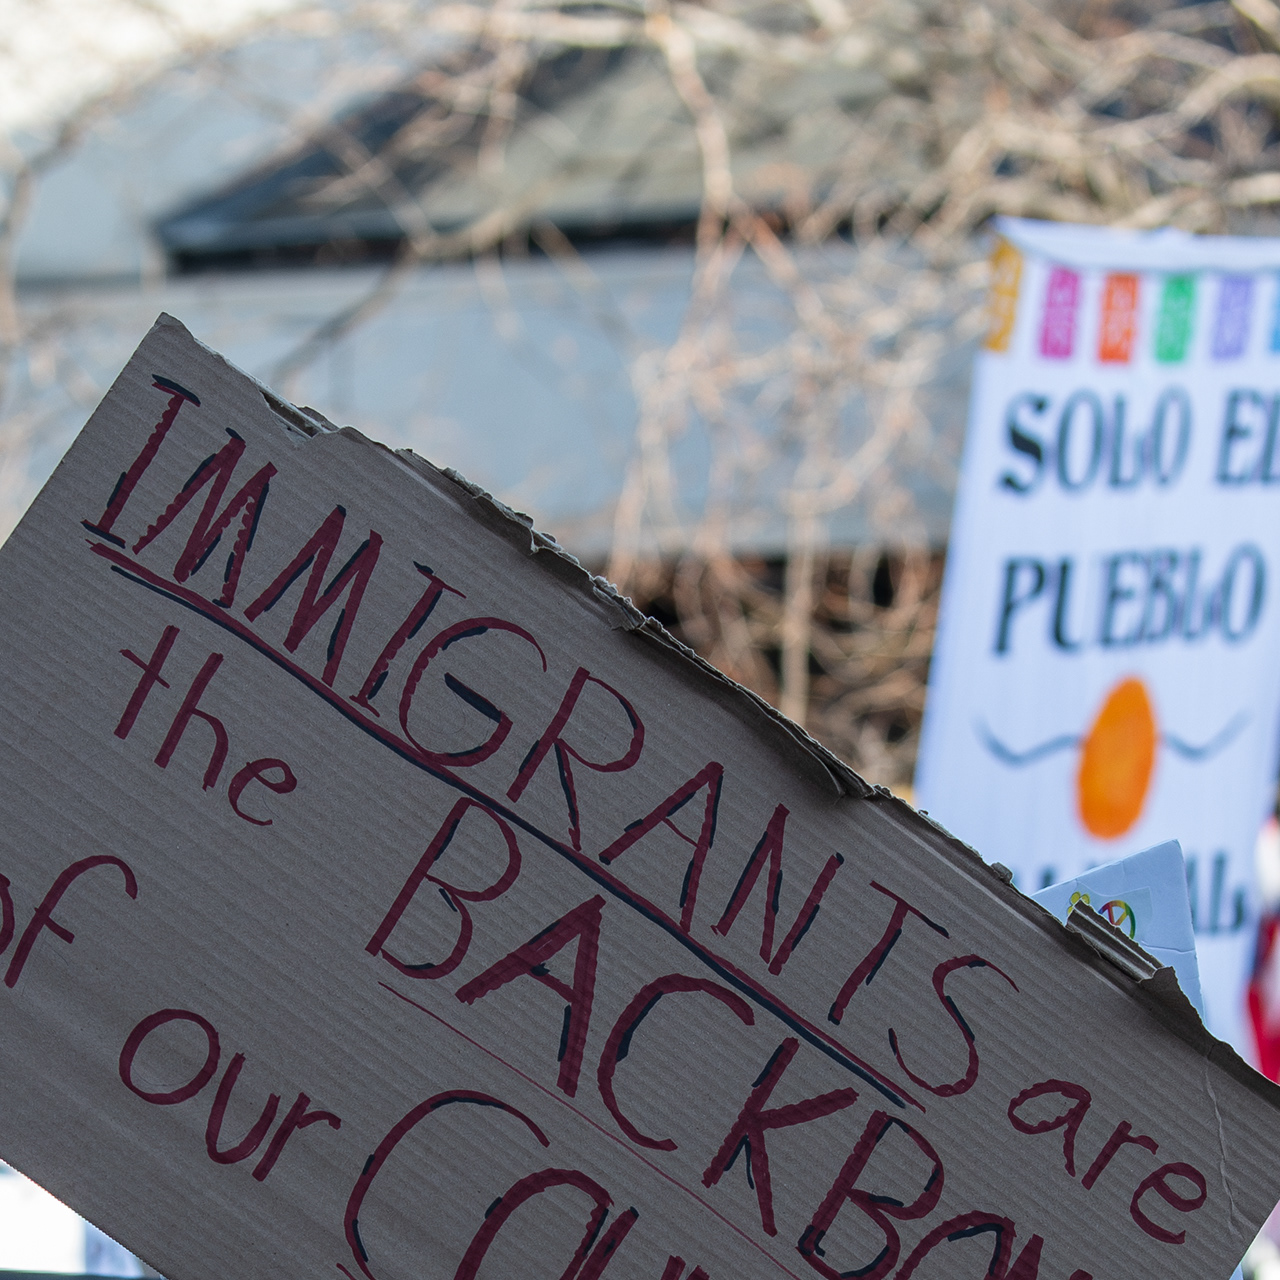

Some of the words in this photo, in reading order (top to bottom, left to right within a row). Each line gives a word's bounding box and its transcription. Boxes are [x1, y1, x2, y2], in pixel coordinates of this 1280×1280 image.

[996, 386, 1192, 495] SOLO
[992, 542, 1268, 657] PUEBLO
[81, 375, 1019, 1097] IMMIGRANTS
[1008, 1079, 1207, 1243] are
[114, 625, 297, 825] the
[120, 1009, 341, 1181] our
